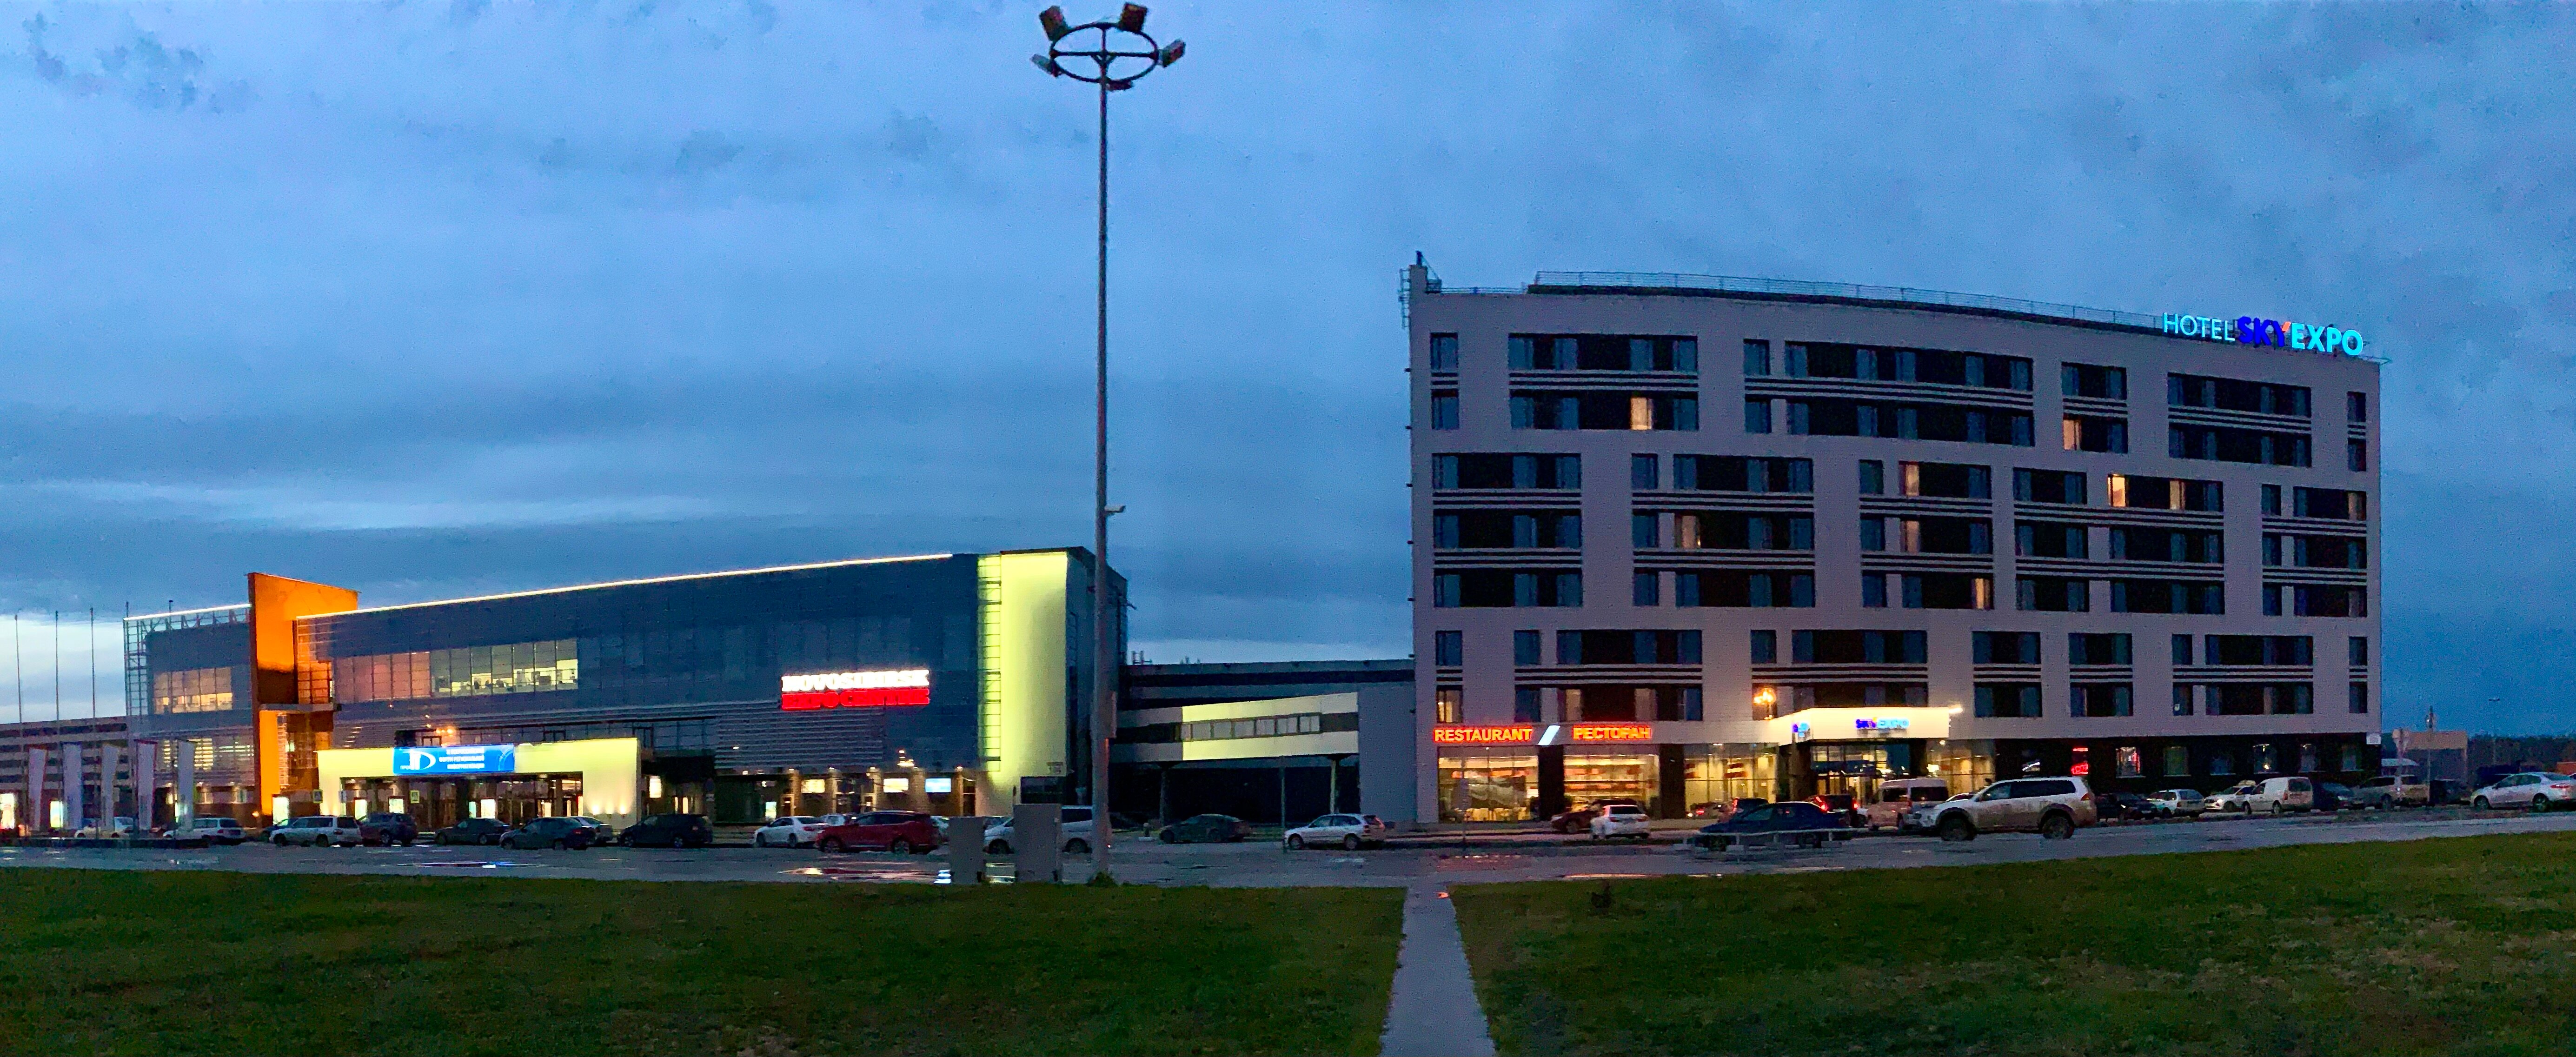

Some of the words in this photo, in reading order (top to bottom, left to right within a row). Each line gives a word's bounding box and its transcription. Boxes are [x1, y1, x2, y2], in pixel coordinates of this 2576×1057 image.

[2163, 312, 2235, 341] HOTEL
[1434, 728, 1533, 742] RESTAURANT
[1573, 727, 1652, 739] РЕСТОРАН
